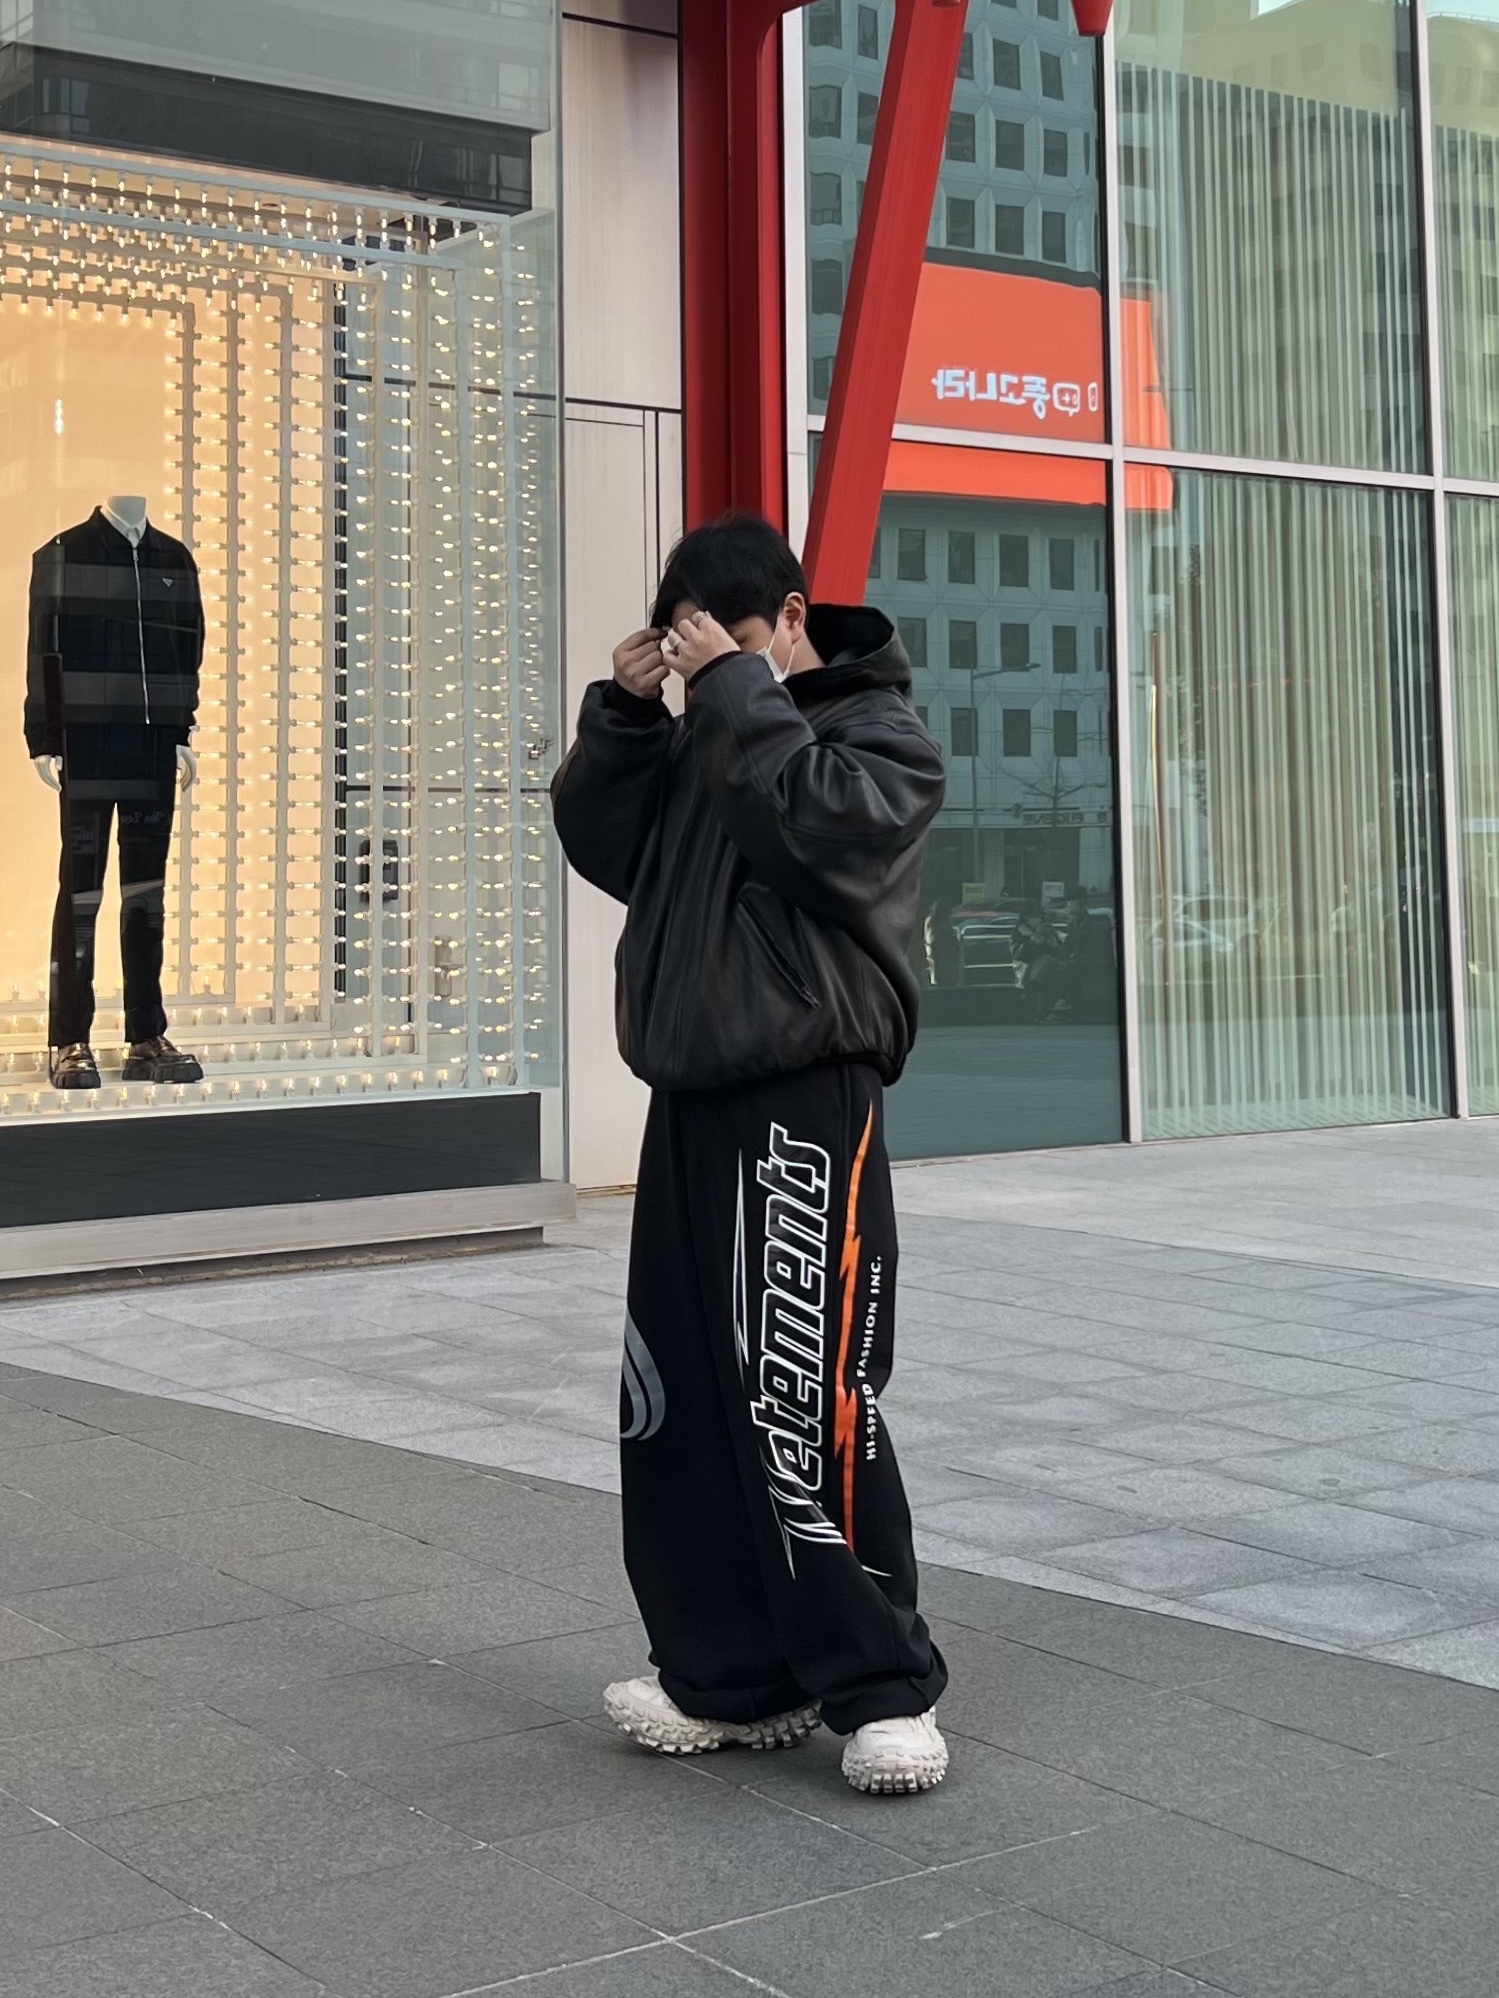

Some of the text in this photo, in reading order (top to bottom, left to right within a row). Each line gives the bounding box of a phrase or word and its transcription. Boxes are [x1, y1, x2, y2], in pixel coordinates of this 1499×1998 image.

[857, 1255, 882, 1460] HI-SPEED FASHION INC.
